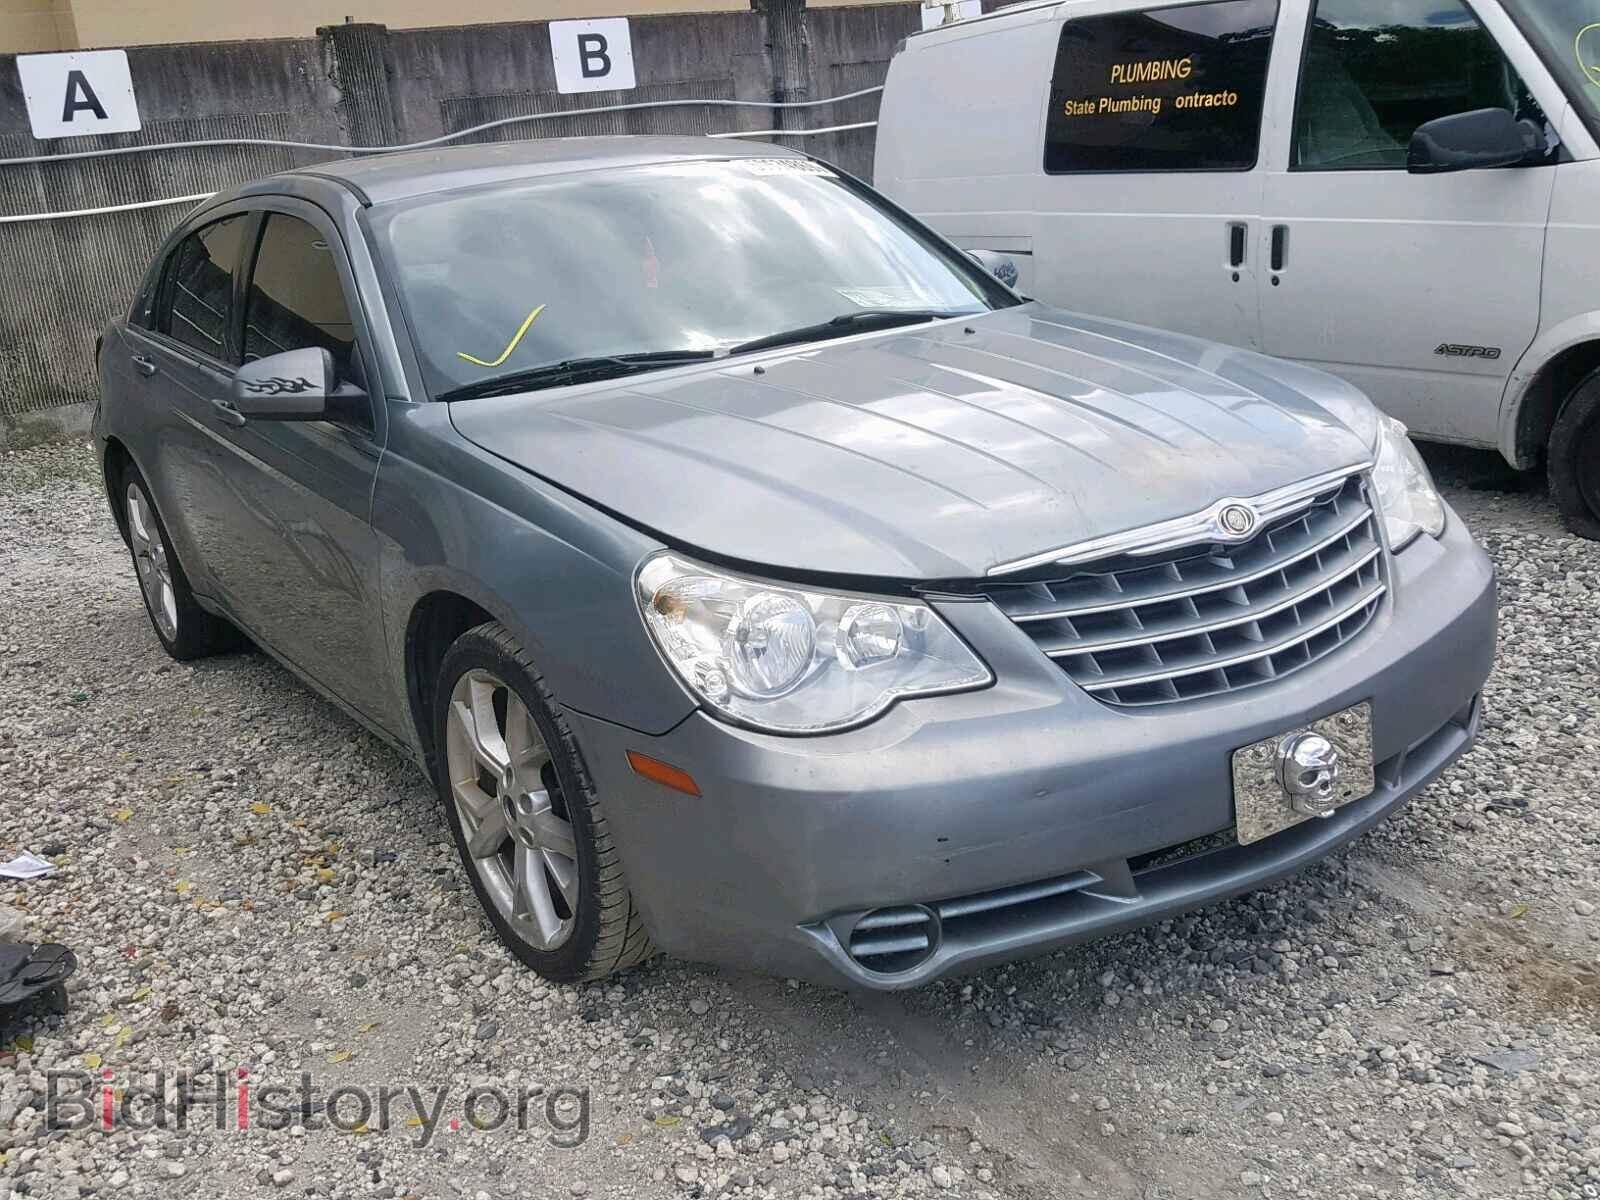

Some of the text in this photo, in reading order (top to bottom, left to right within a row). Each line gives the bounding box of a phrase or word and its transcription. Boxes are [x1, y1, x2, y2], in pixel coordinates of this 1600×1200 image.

[577, 33, 612, 78] B
[1110, 58, 1192, 83] PLUMBING
[62, 69, 109, 122] A
[1064, 100, 1096, 116] State
[1099, 94, 1162, 114] Plumbing
[1433, 343, 1501, 360] ASTRO
